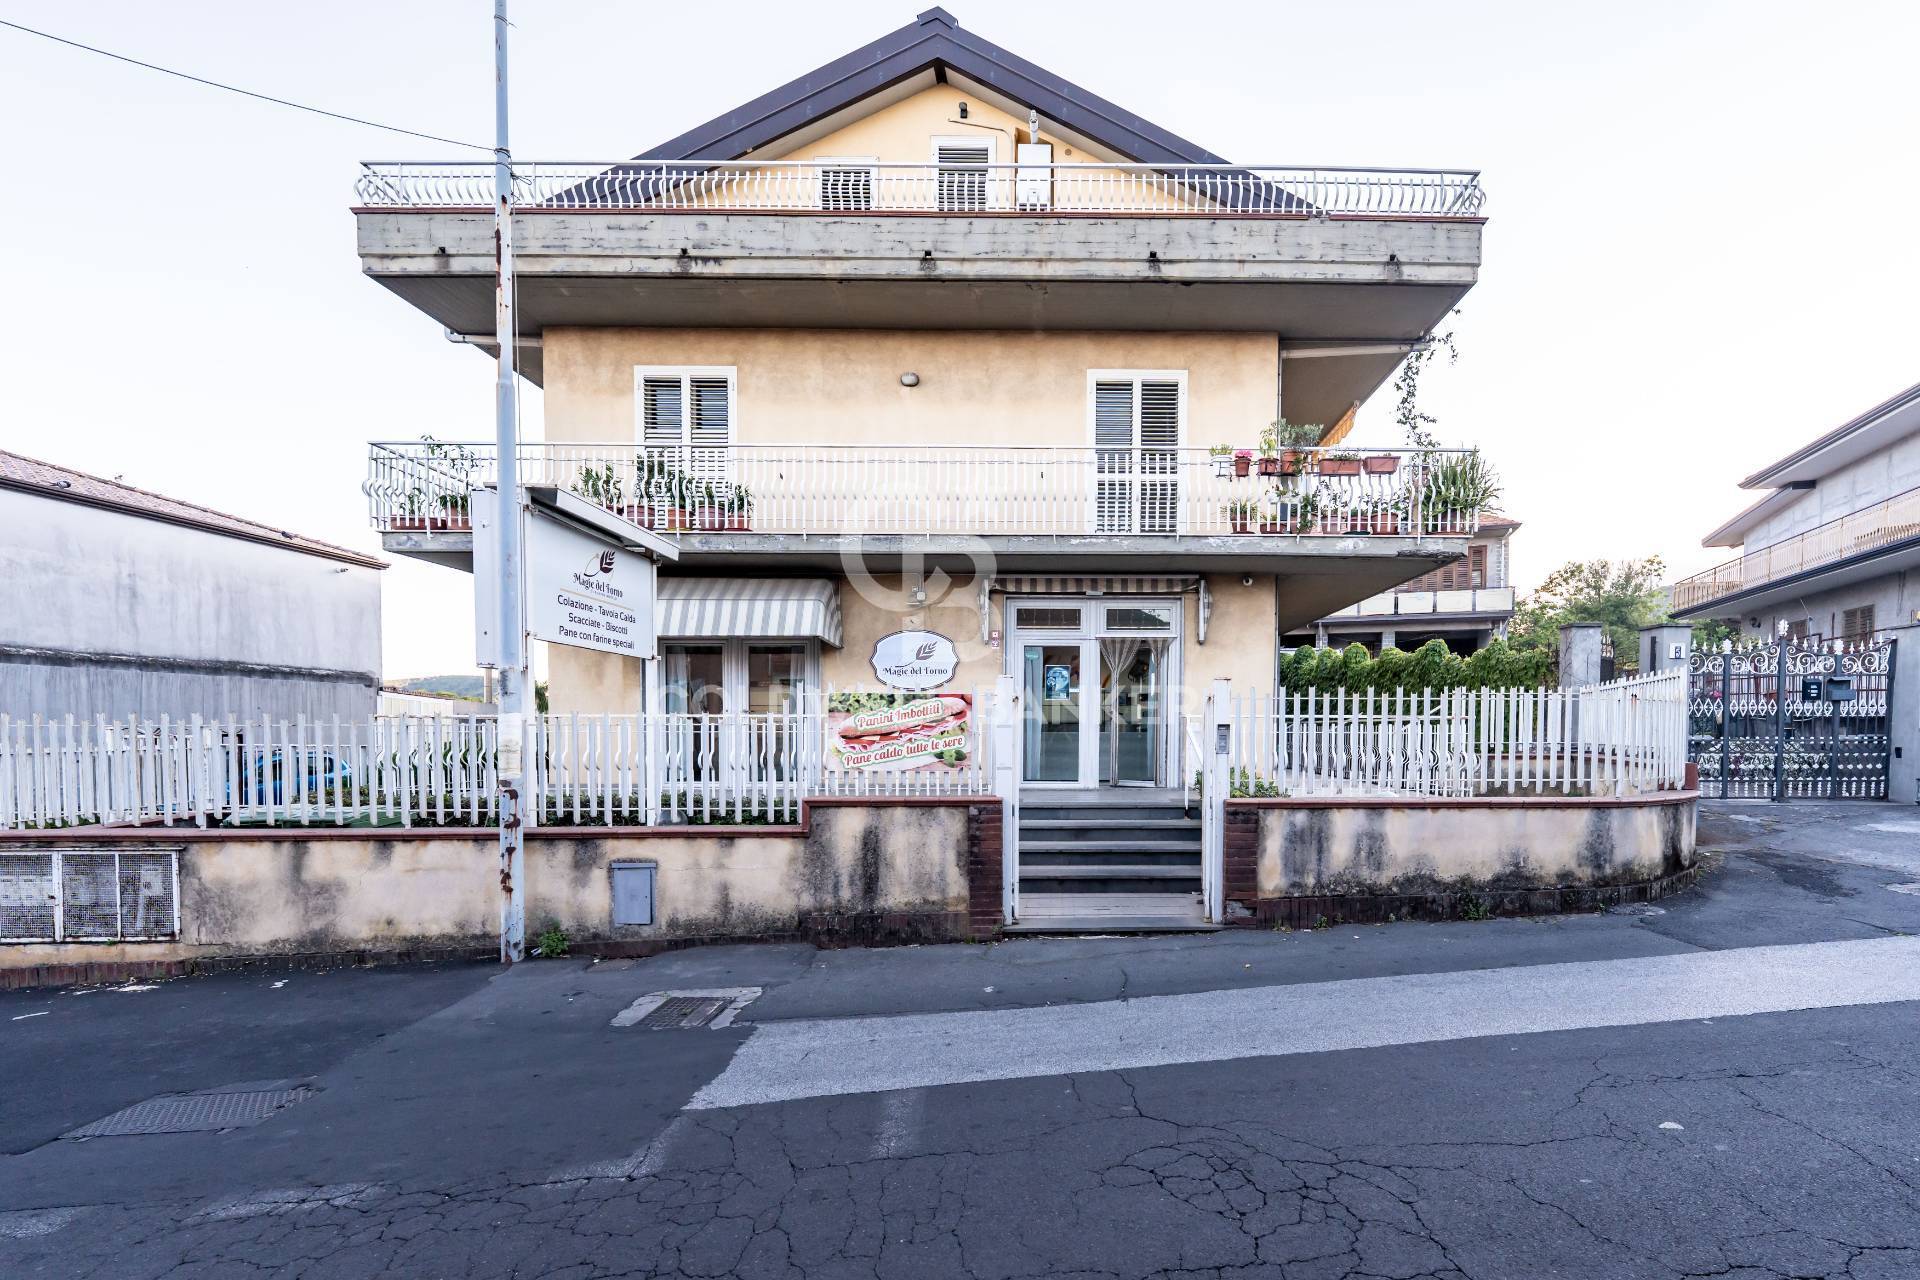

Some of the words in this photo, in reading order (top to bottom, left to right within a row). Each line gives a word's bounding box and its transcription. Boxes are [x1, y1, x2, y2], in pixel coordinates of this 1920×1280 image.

[557, 595, 593, 612] Colazione
[598, 605, 618, 619] Tavola
[619, 611, 636, 624] Calda
[568, 612, 601, 629] Scacciate
[605, 621, 628, 635] Biscotti
[559, 625, 578, 638] Pane
[579, 631, 592, 641] con
[592, 632, 612, 645] farine
[612, 638, 635, 650] speciali
[882, 666, 908, 677] Magie
[910, 666, 922, 675] del
[857, 711, 894, 728] Panini
[893, 702, 941, 721] Imbottiti
[844, 754, 872, 767] Pane
[873, 747, 904, 761] caldo
[906, 742, 929, 755] tutte
[931, 739, 940, 751] le
[942, 737, 963, 749] sere
